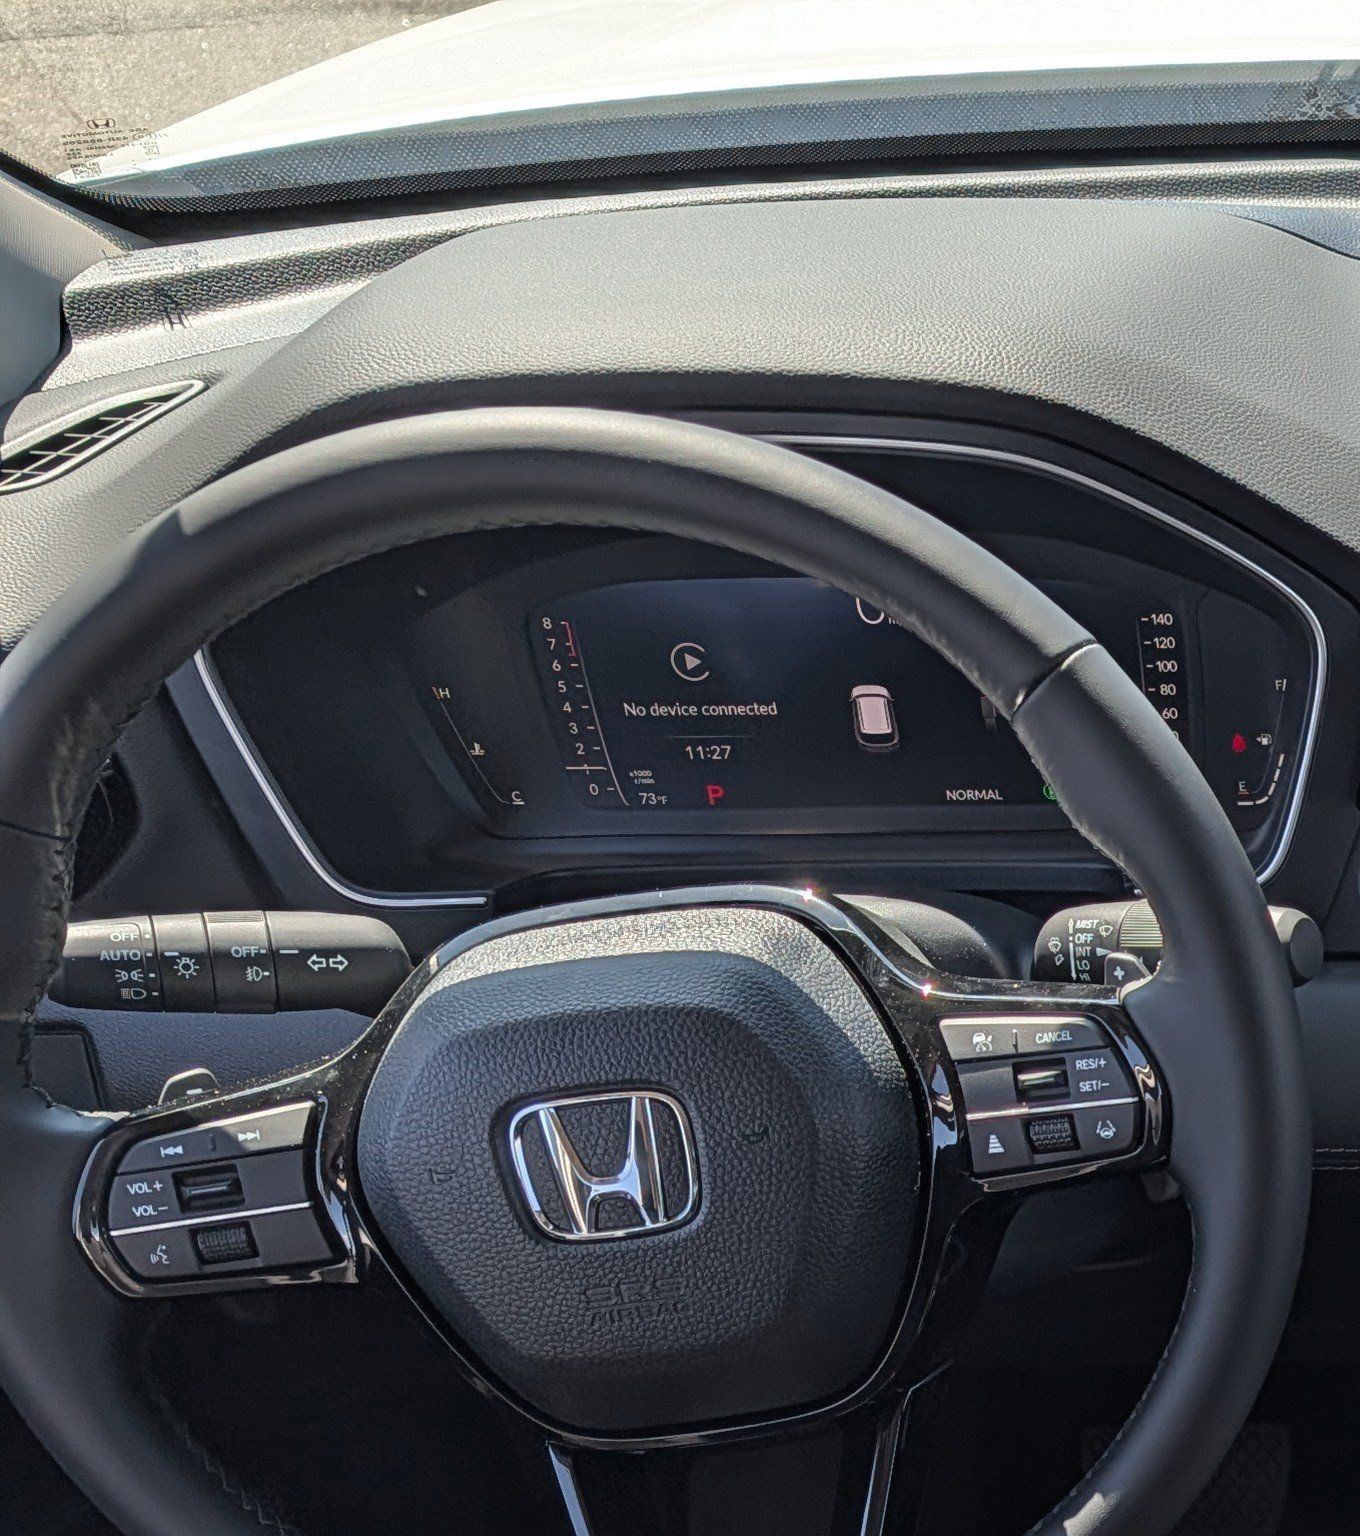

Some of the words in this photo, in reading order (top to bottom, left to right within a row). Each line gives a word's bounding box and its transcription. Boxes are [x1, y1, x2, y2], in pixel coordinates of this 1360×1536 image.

[542, 617, 552, 630] 8
[1150, 613, 1173, 626] 140
[546, 638, 556, 651] 7
[1153, 637, 1176, 649] 120
[552, 659, 562, 672] 6
[1155, 660, 1178, 673] 100
[558, 680, 567, 693] 5
[1160, 684, 1177, 696] 80
[562, 701, 572, 714] 4
[623, 702, 647, 717] No
[650, 702, 698, 717] device
[701, 701, 778, 717] connected
[1162, 707, 1179, 720] 60
[568, 722, 579, 735] 3
[575, 743, 586, 756] 2
[685, 745, 732, 760] 11:27
[589, 783, 599, 796] 0
[706, 784, 725, 805] P
[945, 789, 1003, 801] NORMAL
[110, 931, 139, 942] OFF
[1075, 933, 1093, 944] OFF
[100, 949, 141, 961] AUTO
[231, 946, 259, 957] OFF
[1076, 960, 1090, 970] LO
[1035, 1030, 1073, 1044] CANCEL
